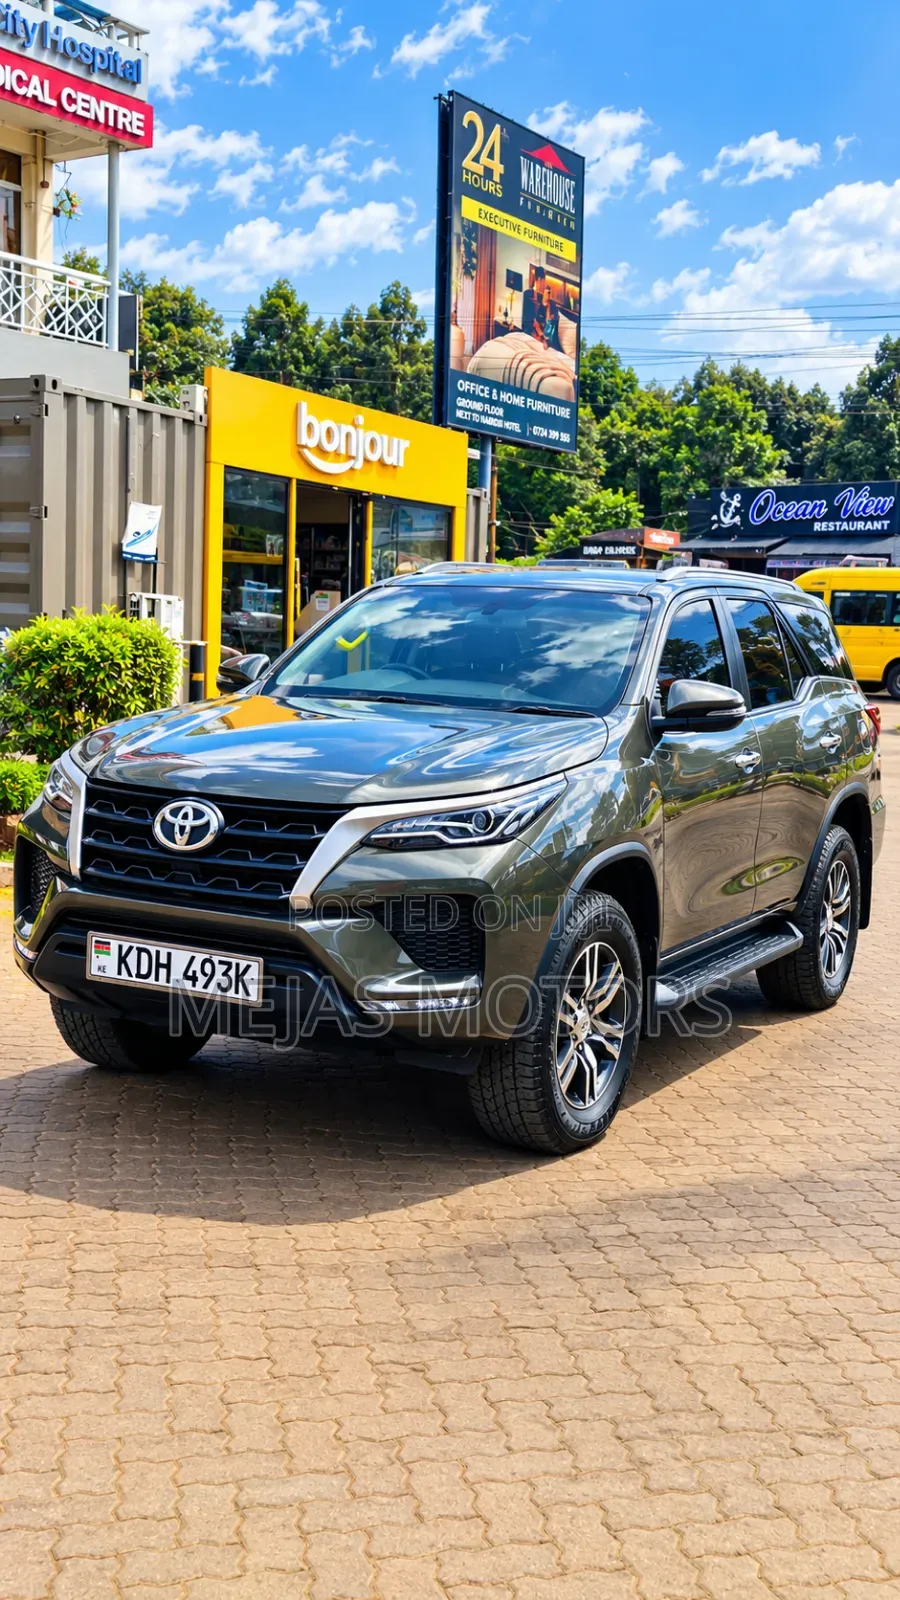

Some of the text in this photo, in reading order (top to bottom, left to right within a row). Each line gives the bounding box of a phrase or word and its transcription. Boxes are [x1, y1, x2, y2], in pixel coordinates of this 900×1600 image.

[44, 20, 142, 84] Hospital
[60, 87, 145, 137] CENTRE
[461, 110, 504, 183] 24
[462, 169, 503, 198] HOURS
[520, 155, 575, 214] WAREHOUSE
[478, 208, 521, 235] EXECUTIVE
[523, 227, 564, 252] FURNITURE
[456, 396, 505, 417] GROUND FLOOR
[457, 379, 571, 419] OFFICE & HOME FURNITURE
[297, 401, 411, 470] bonjour
[456, 409, 471, 421] NEXT
[471, 412, 480, 423] TO
[503, 420, 522, 433] HOTEL
[749, 485, 895, 525] Ocean View
[813, 520, 891, 532] RESTAURANT
[97, 964, 107, 973] KE
[117, 943, 253, 997] KDH 493K
